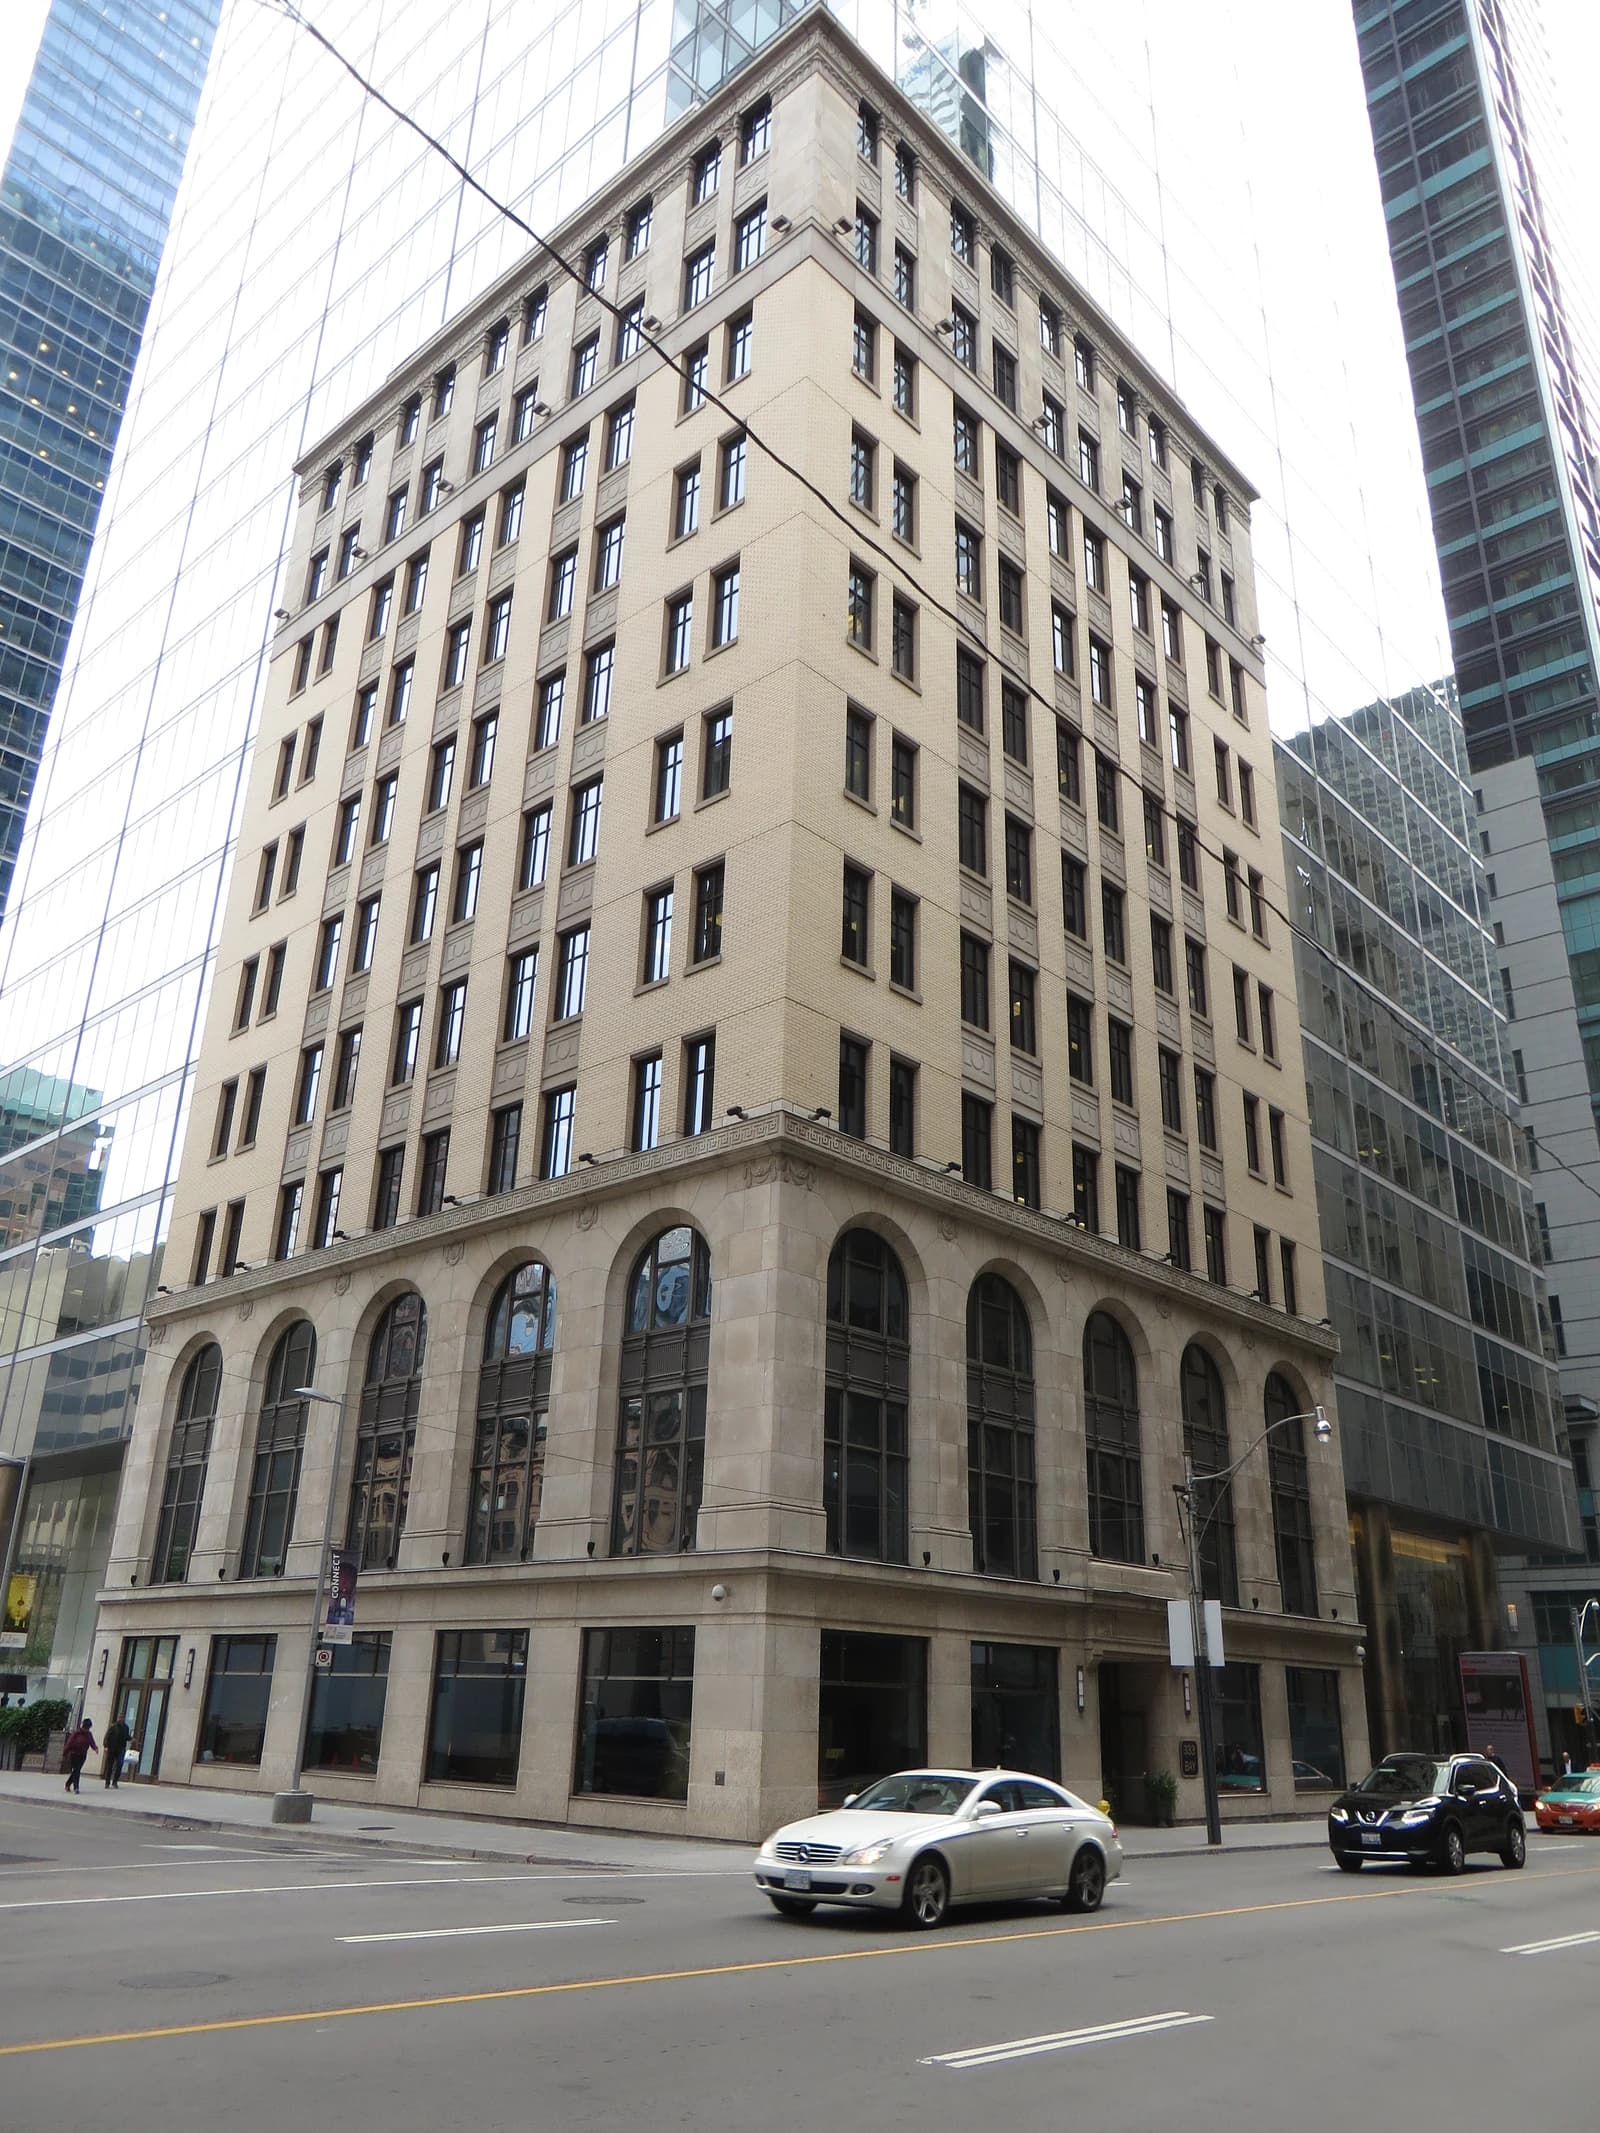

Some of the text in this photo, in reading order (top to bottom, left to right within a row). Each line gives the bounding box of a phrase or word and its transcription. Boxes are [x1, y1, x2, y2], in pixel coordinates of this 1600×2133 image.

[331, 1553, 341, 1599] CONNECT
[1183, 1745, 1196, 1757] 333
[1184, 1760, 1197, 1772] BAY
